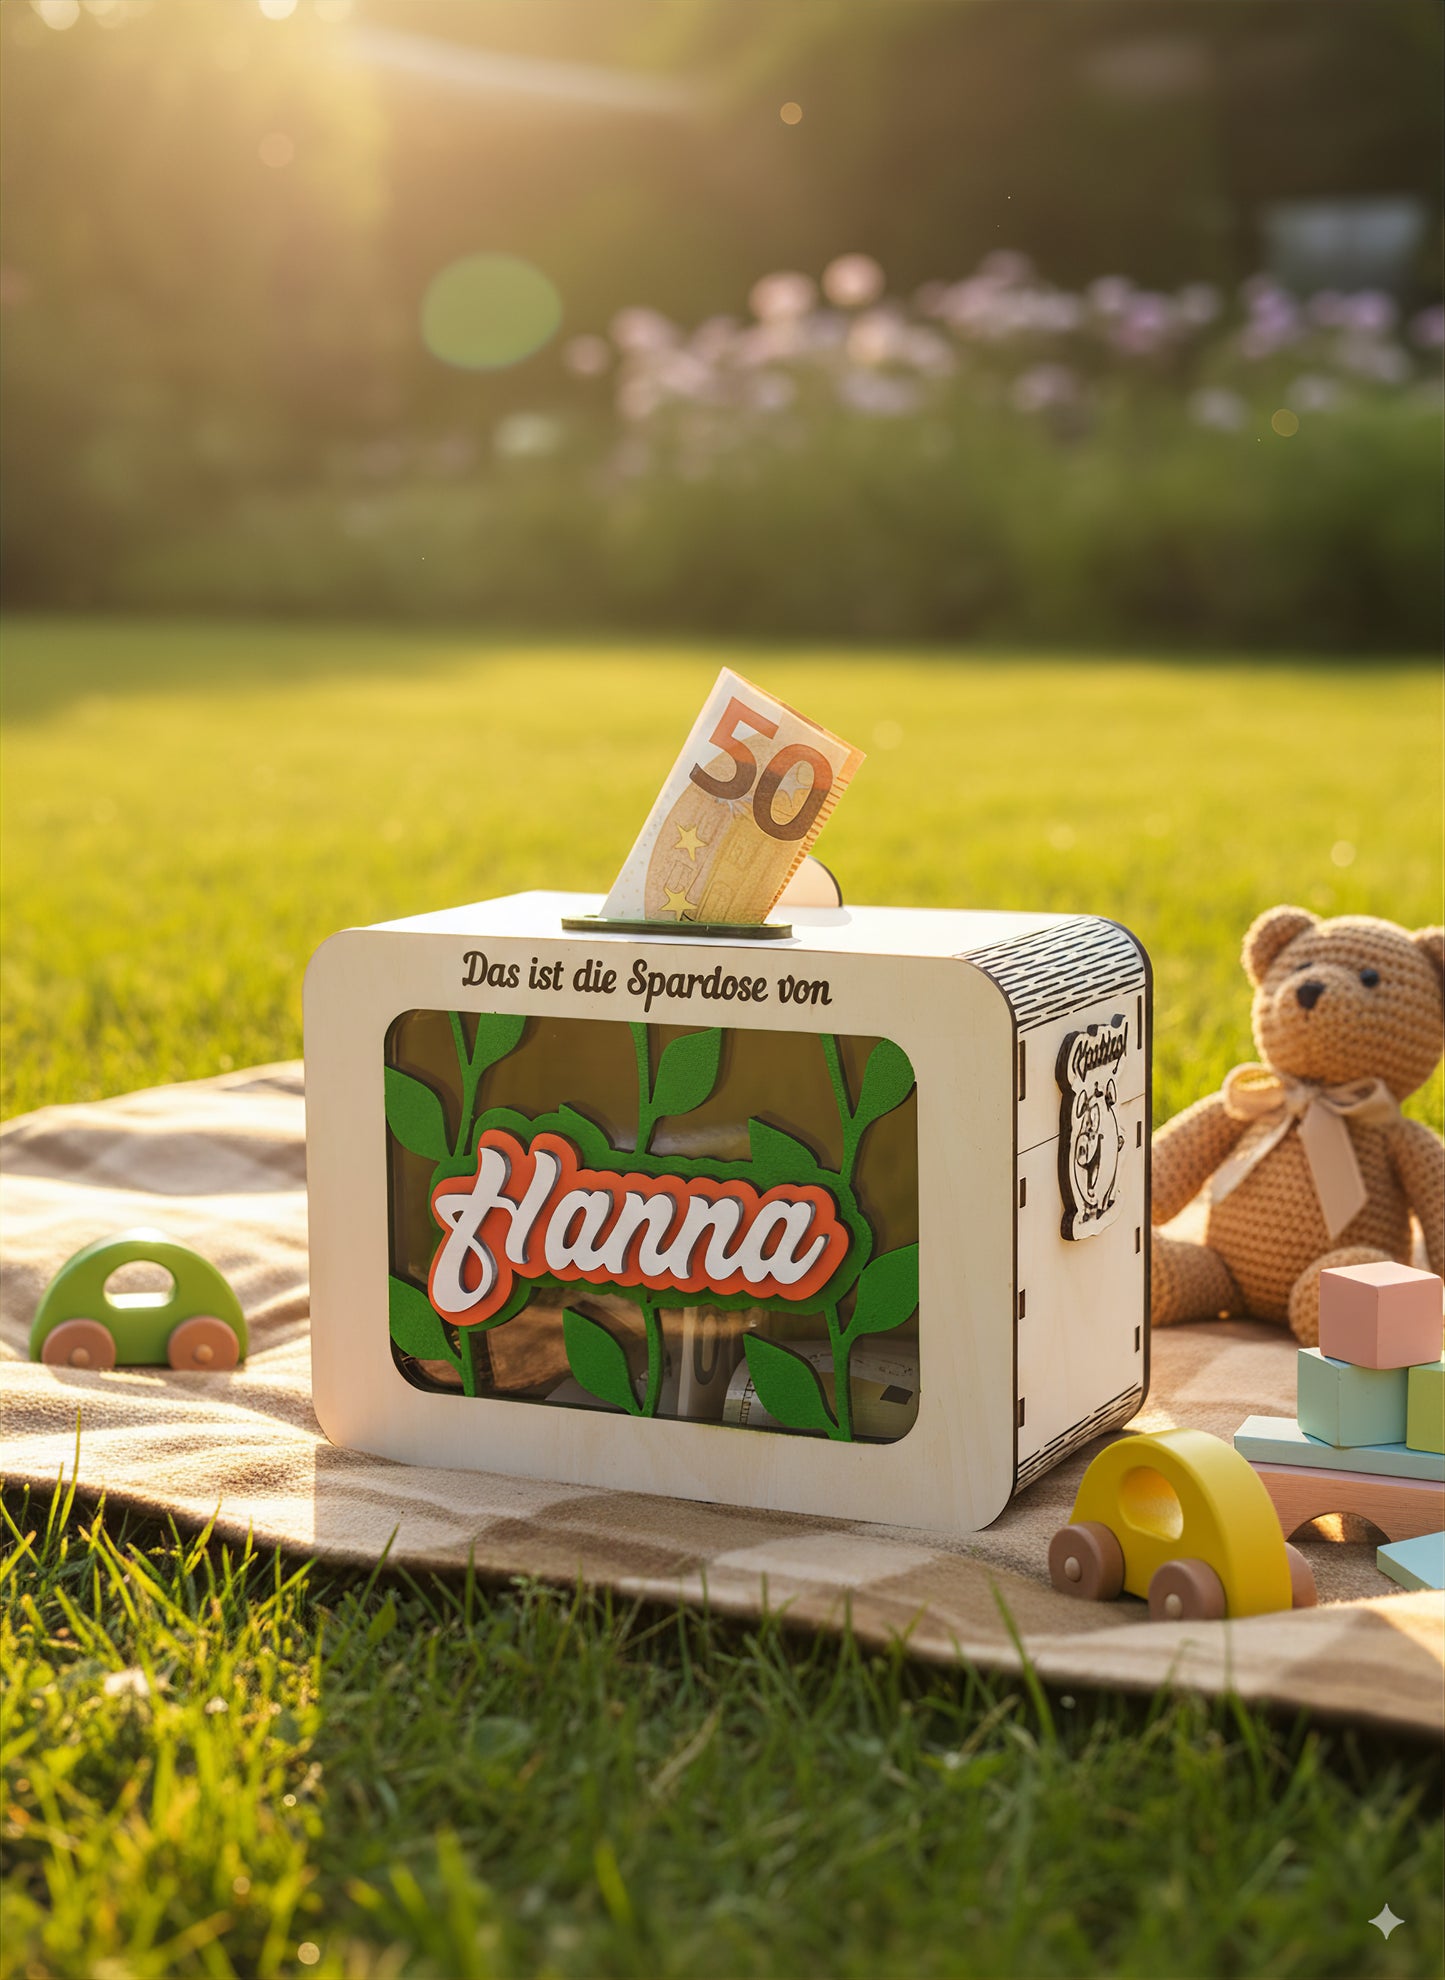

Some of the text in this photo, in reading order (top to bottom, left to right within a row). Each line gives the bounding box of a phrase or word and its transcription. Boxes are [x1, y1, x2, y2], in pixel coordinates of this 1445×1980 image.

[689, 696, 834, 842] 50
[461, 950, 833, 1013] Das ist die Spardose von
[433, 1147, 830, 1314] Hanna
